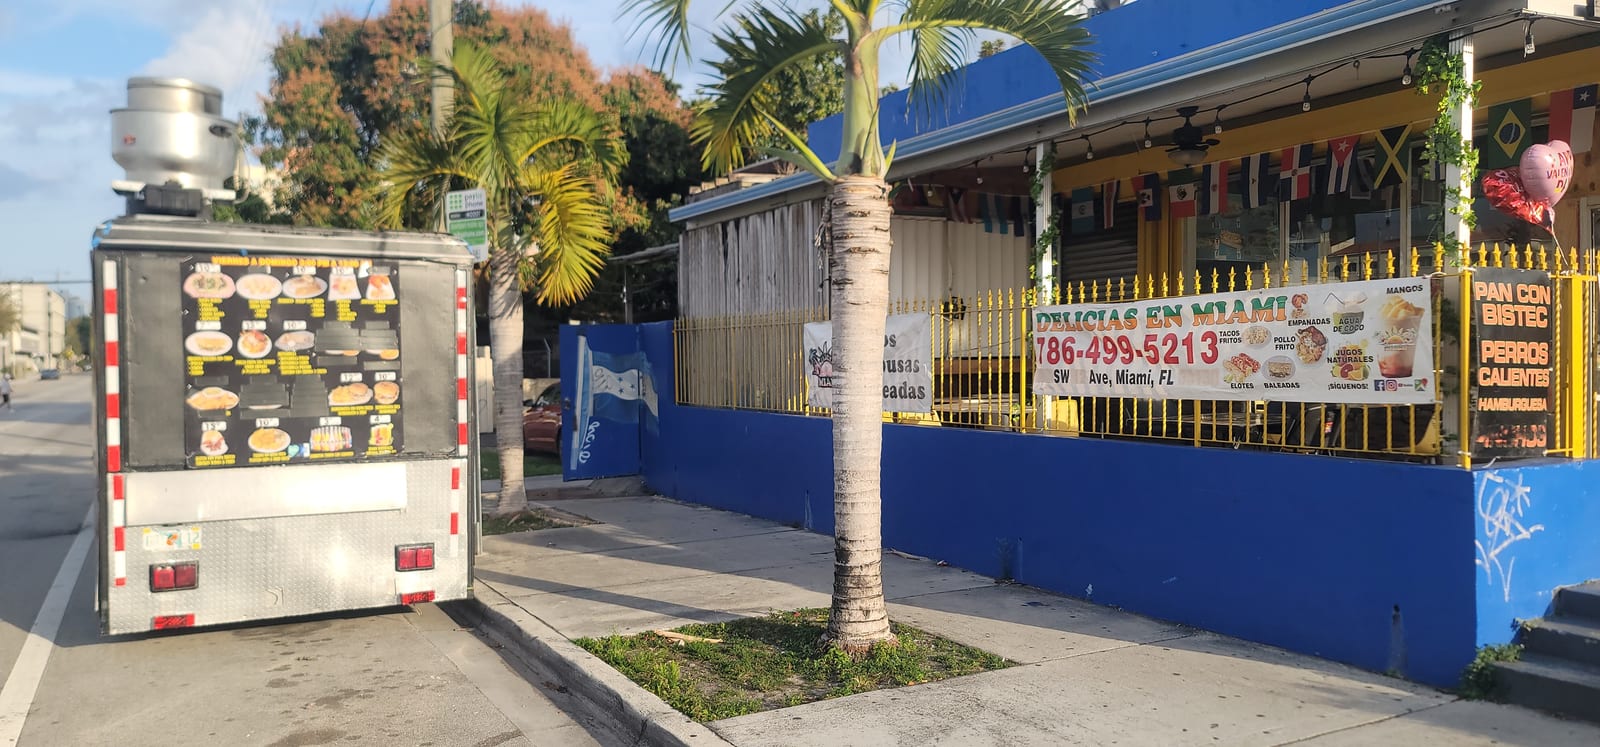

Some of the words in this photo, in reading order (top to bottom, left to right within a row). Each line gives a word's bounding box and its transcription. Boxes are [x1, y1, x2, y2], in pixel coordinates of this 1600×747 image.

[250, 257, 258, 266] A
[258, 256, 298, 267] DOMINGO
[1386, 284, 1424, 295] MANGOS
[1474, 282, 1513, 302] PAN
[1516, 283, 1550, 305] CON
[1036, 308, 1138, 332] DELICIAS
[1146, 304, 1183, 329] EN
[1191, 295, 1288, 327] MIAMI
[1288, 317, 1331, 326] EMPANADAS
[1338, 317, 1361, 325] AGUA
[1481, 304, 1548, 328] BISTEC
[1333, 325, 1343, 333] DE
[1037, 331, 1219, 365] 786-499-5213
[1275, 343, 1295, 351] FRITO
[1481, 340, 1549, 365] PERROS
[1327, 355, 1374, 364] NATURALES
[1053, 369, 1070, 383] SW
[1089, 370, 1112, 387] Ave,
[1116, 369, 1154, 388] Miami,
[1159, 370, 1174, 385] FL
[1479, 366, 1549, 387] CALIENTES
[883, 381, 925, 399] eadas
[1477, 397, 1547, 412] HAMBURGUESA
